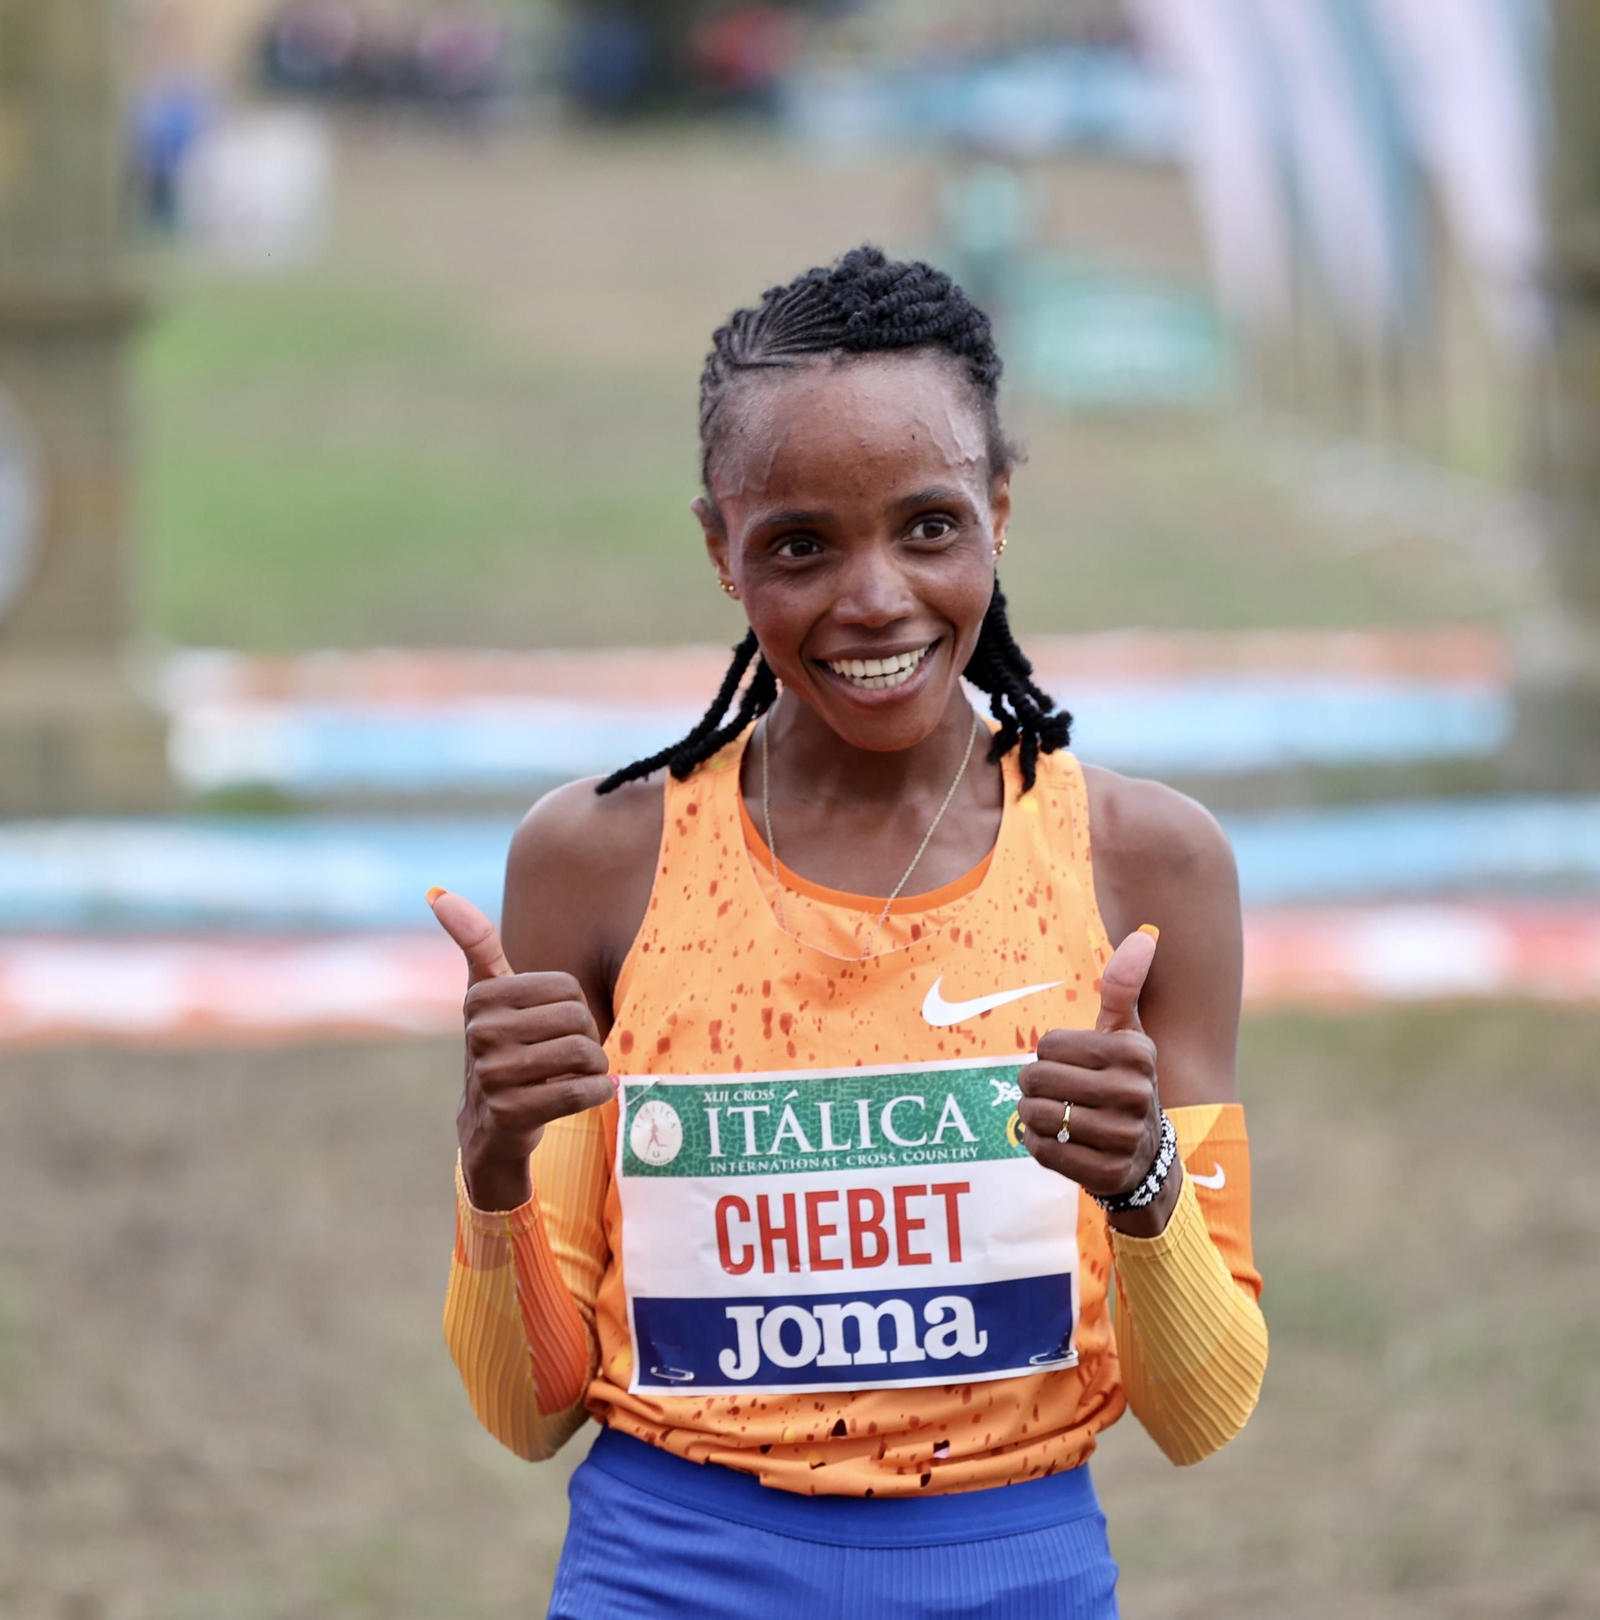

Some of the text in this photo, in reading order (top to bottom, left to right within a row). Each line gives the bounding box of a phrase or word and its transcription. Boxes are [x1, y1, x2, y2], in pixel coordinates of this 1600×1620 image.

[703, 1088, 776, 1104] XLII CROSS
[703, 1089, 980, 1158] ITÁLICA
[710, 1147, 979, 1174] INTERNATIONAL CROSS COUNTRY
[714, 1182, 970, 1276] CHEBET
